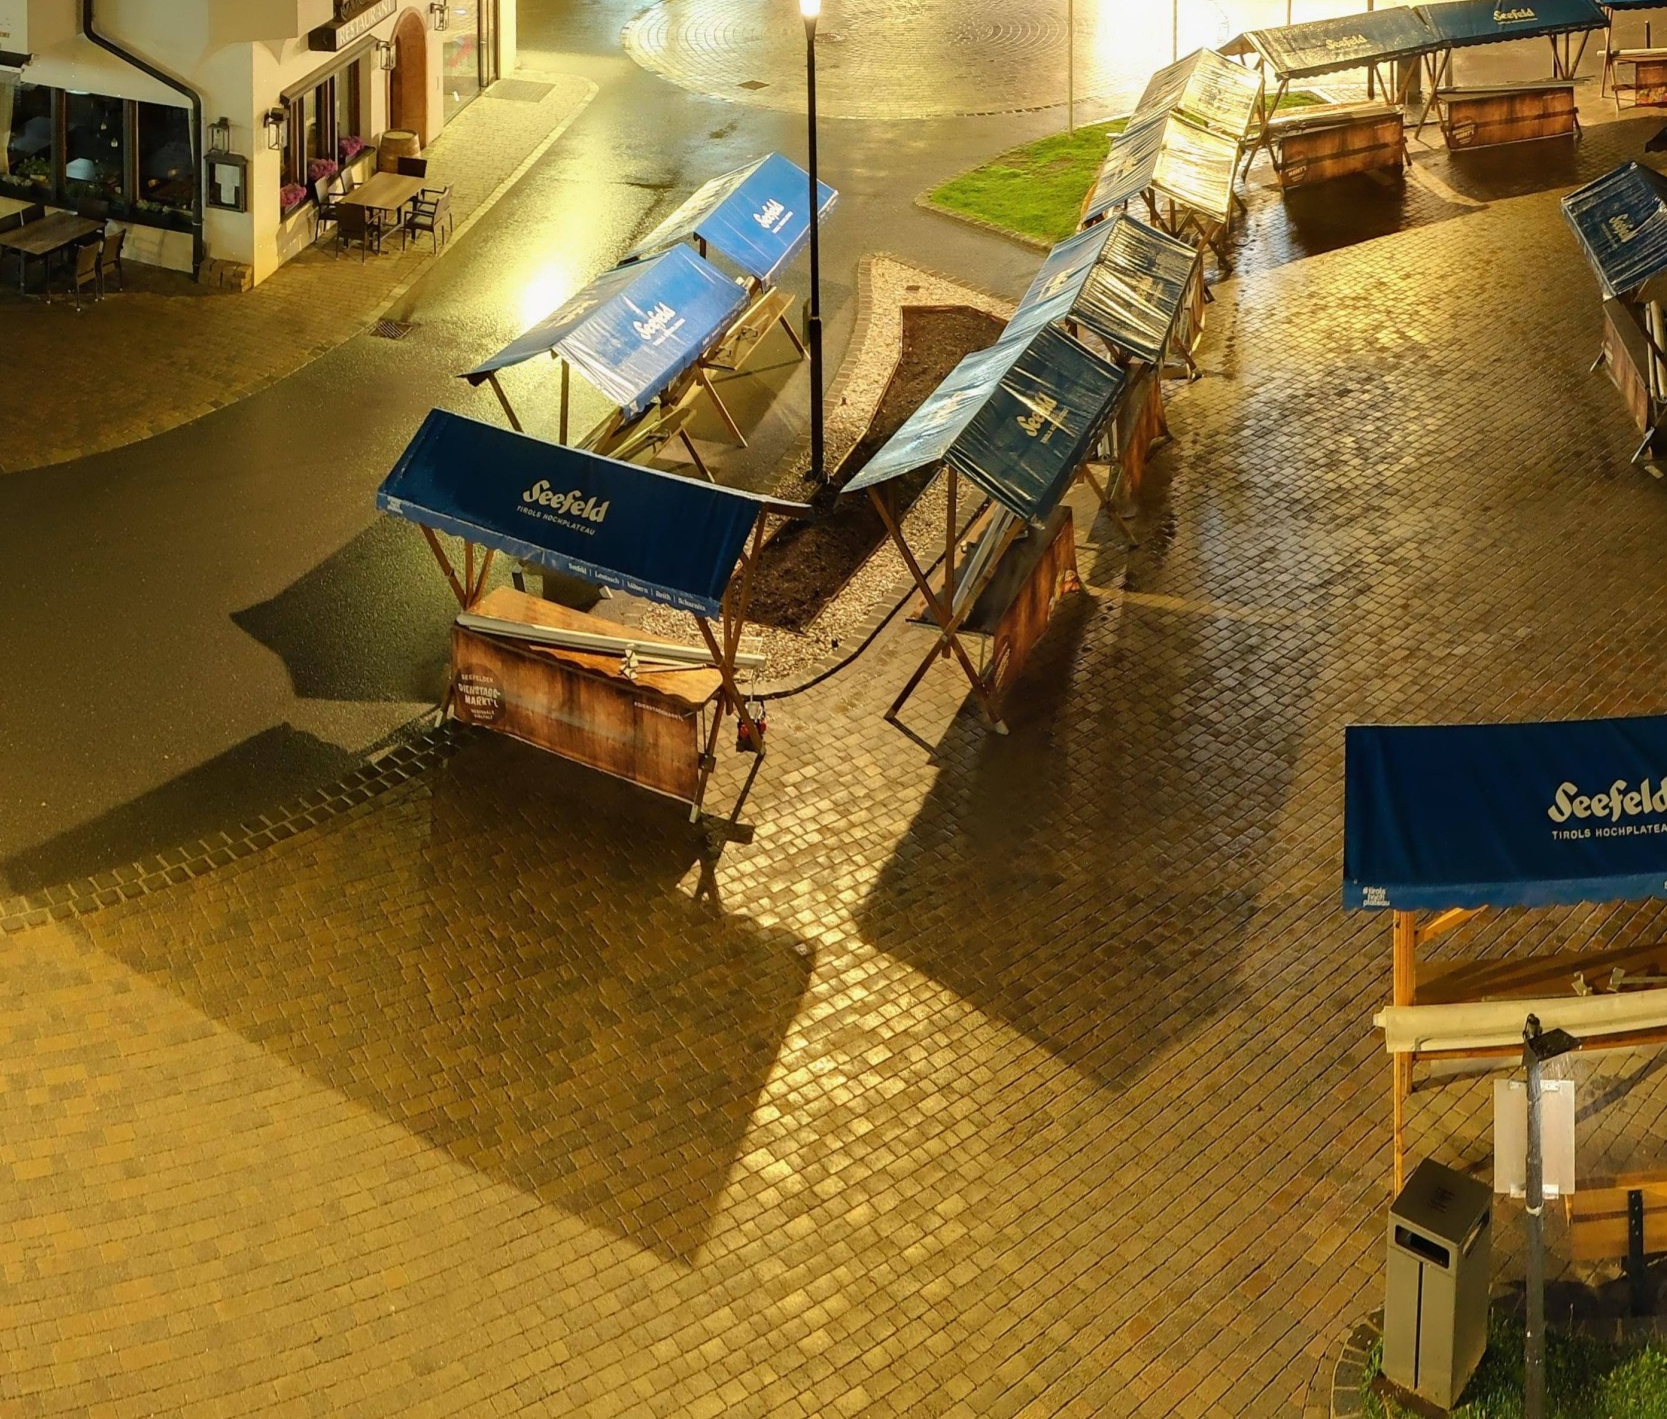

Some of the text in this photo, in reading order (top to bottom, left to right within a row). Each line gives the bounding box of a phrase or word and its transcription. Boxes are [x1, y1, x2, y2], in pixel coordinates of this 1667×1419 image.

[339, 0, 393, 45] RESTAURANT
[1493, 8, 1535, 22] Seefeld
[522, 480, 610, 523] Seefeld
[516, 505, 596, 536] TIROLS HOCHPLATEAU
[1552, 828, 1591, 840] TIROLS
